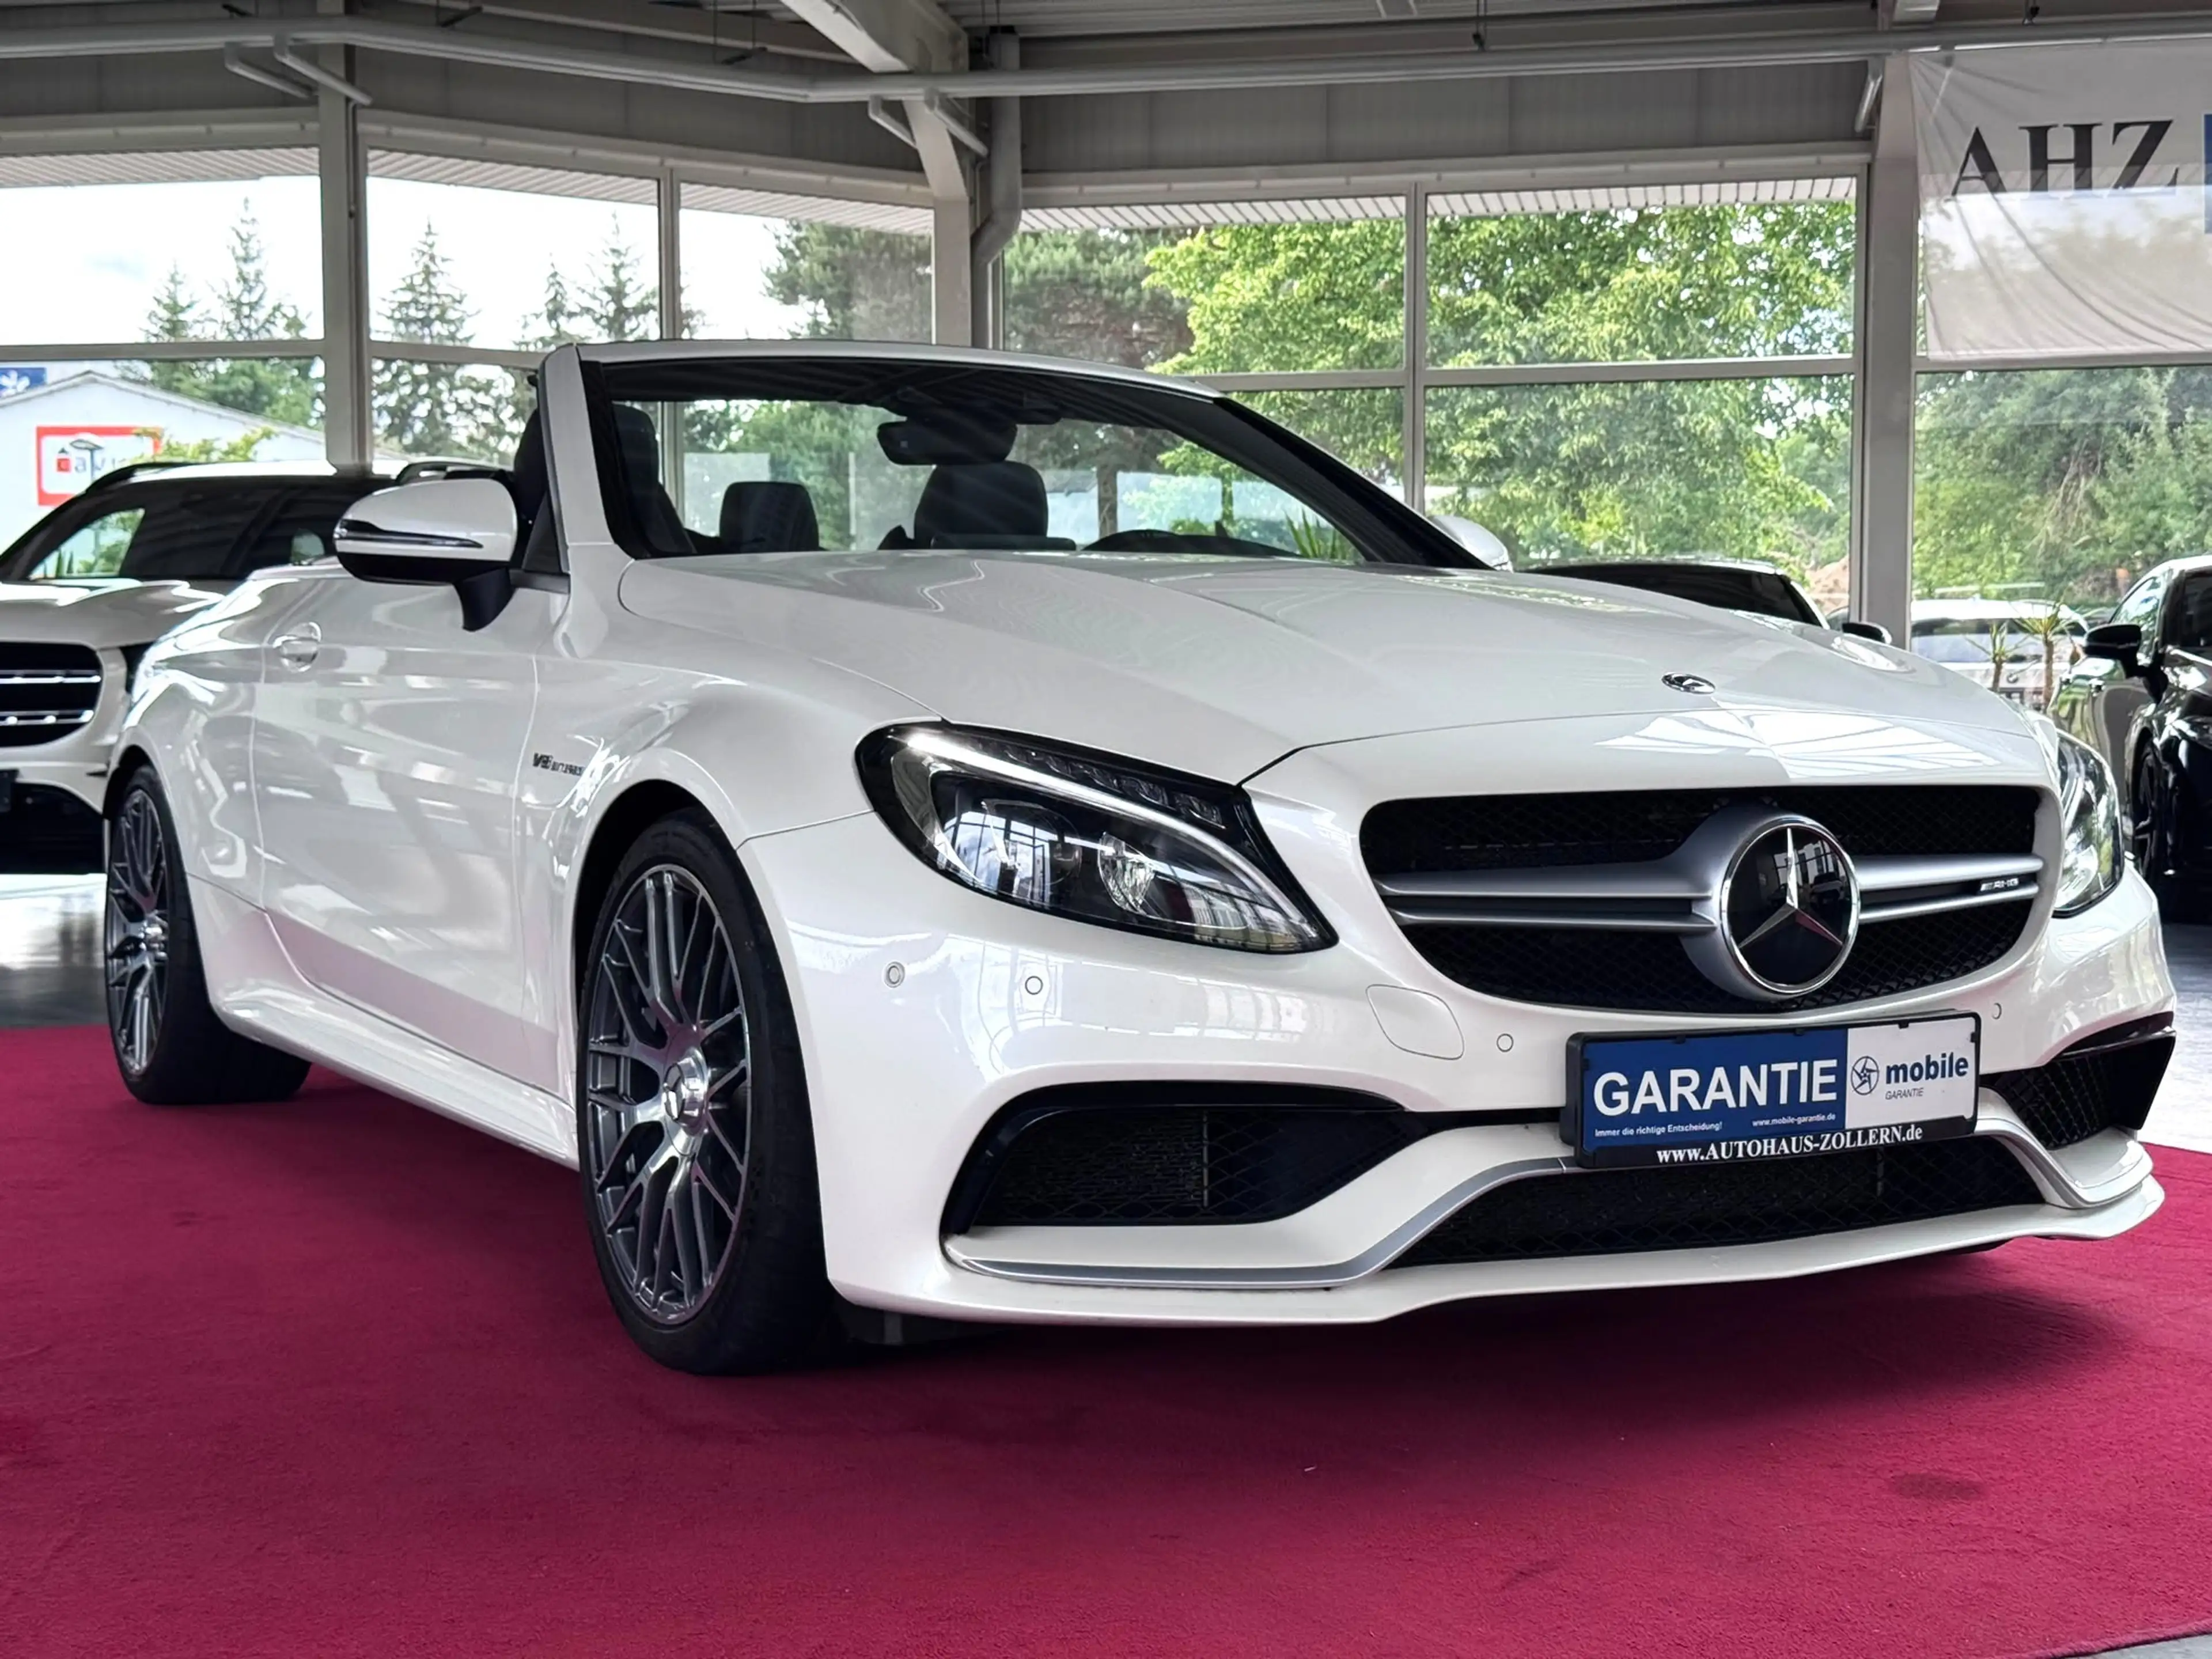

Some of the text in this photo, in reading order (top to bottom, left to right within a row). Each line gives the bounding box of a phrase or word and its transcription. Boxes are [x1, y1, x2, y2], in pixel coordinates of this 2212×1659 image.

[1944, 119, 2180, 200] AHZ
[1885, 1052, 1969, 1084] mobile
[1593, 1059, 1838, 1116] GARANTIE
[1885, 1087, 1925, 1100] GARANTIE
[1594, 1121, 1723, 1137] Immer die richtige Entscheidung!
[1752, 1112, 1836, 1127] www.mobile-garantie.de
[1656, 1124, 1923, 1163] www.AUTOHAUS-ZOLLERN.de
